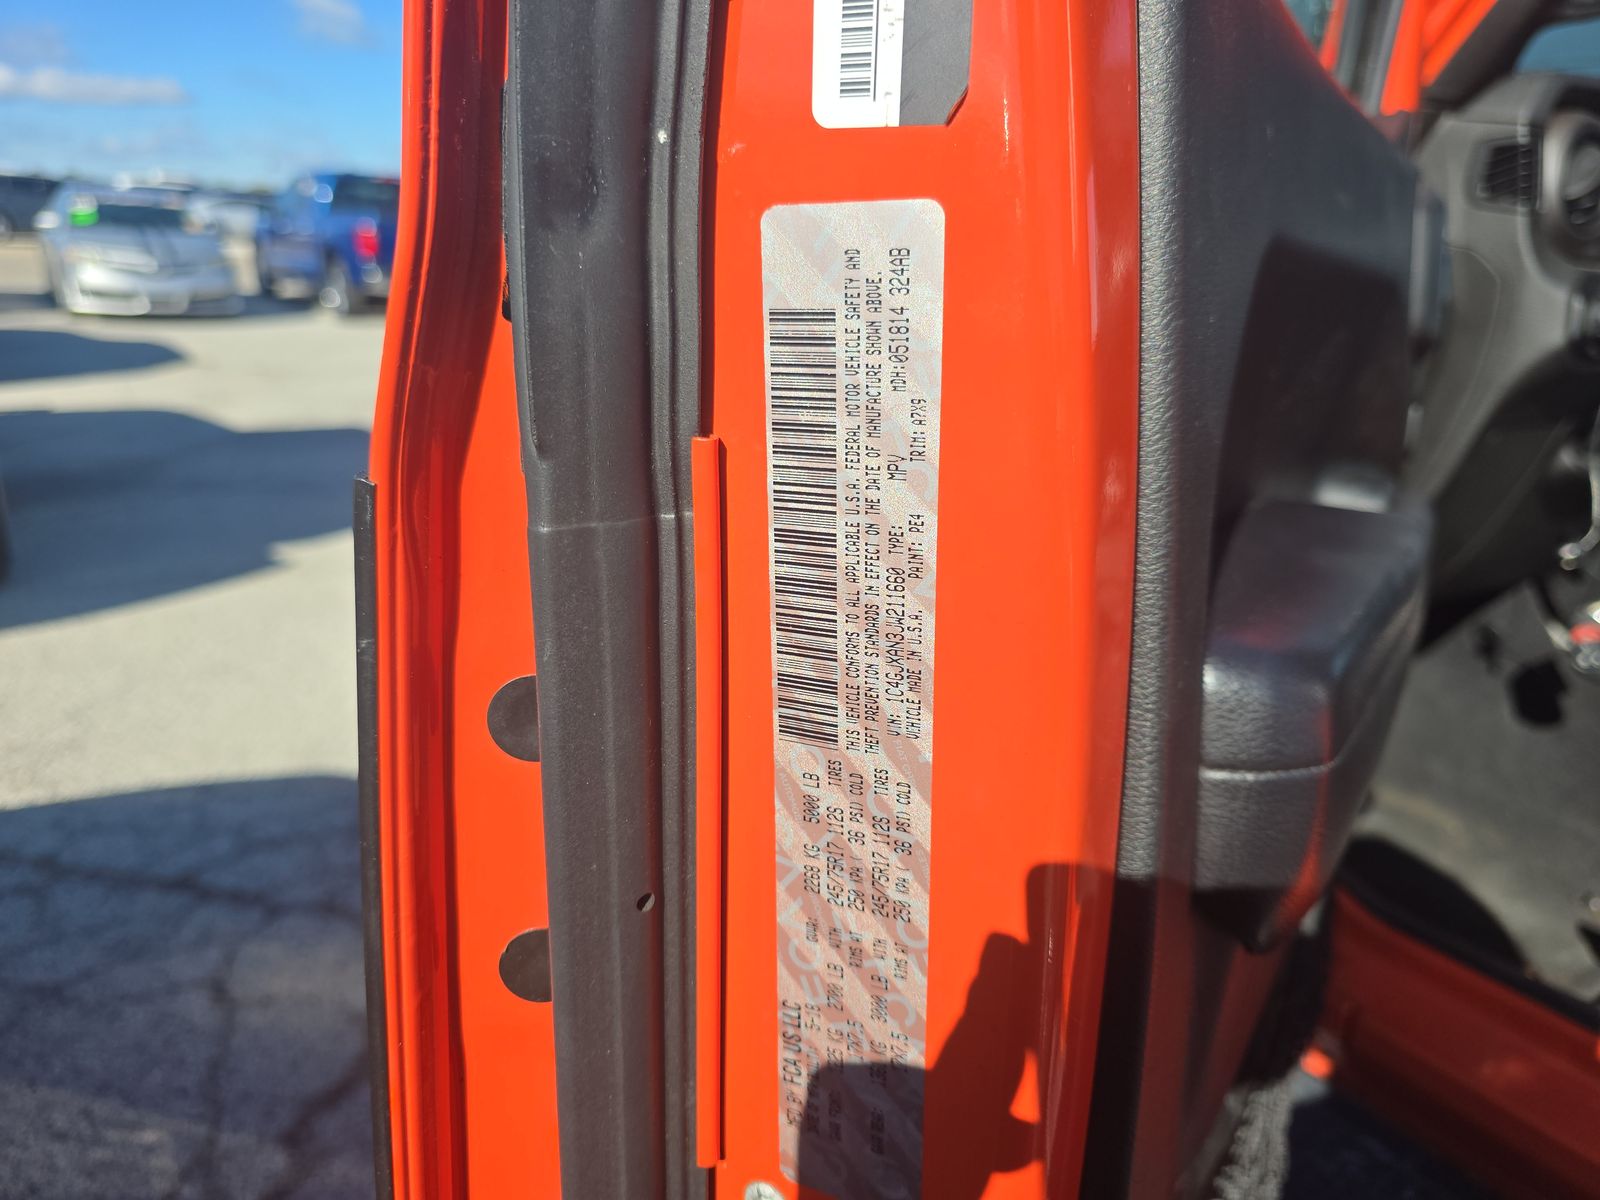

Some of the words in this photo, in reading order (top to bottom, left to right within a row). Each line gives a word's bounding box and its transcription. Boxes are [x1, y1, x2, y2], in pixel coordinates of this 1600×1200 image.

[845, 249, 860, 269] AND
[889, 248, 910, 296] 324AB
[845, 278, 860, 320] SAFETY
[866, 271, 882, 313] ABOVE.
[866, 321, 882, 355] SHOWN
[889, 306, 909, 392] MDH:051814
[845, 328, 860, 376] VEHICLE
[845, 384, 860, 417] MOTOR
[866, 364, 882, 438] MANUFACTURE
[845, 424, 860, 470] FEDERAL
[866, 445, 880, 458] OF
[910, 432, 926, 462] TRIM:
[866, 466, 880, 490] DATE
[887, 454, 907, 481] MPV
[845, 478, 860, 515] U.S.A.
[865, 498, 880, 515] THE
[865, 524, 880, 535] ON
[909, 514, 924, 533] PE4
[845, 522, 860, 583] APPLICABLE
[888, 526, 904, 554] TYPE:
[865, 542, 880, 579] EFFECT
[908, 542, 923, 579] PAINT:
[846, 590, 860, 607] ALL
[865, 586, 880, 596] IN
[846, 614, 860, 624] TO
[864, 604, 879, 658] STANDARDS
[908, 610, 922, 644] U.S.A.
[886, 568, 905, 703] 1C4GJXAN3JW211660
[846, 632, 860, 678] CONFORMS
[907, 651, 922, 661] IN
[864, 664, 879, 722] PREVENTION
[907, 668, 922, 693] MADE
[846, 684, 860, 724] VEHICLE
[887, 714, 902, 736] VIN:
[906, 700, 921, 739] VEHICLE
[846, 730, 860, 751] THIS
[864, 727, 879, 754] THEFT
[803, 773, 820, 788] LB
[829, 760, 842, 786] TIRES
[850, 772, 864, 796] COLD
[874, 768, 888, 796] TIRES
[896, 782, 911, 805] COLD
[804, 795, 820, 824] 5000
[827, 806, 844, 836] 112S
[850, 802, 864, 824] PSI)
[896, 811, 910, 834] PSI)
[848, 829, 864, 846] 36
[872, 816, 890, 846] 112S
[804, 843, 820, 859] KG
[894, 840, 912, 856] 36
[804, 866, 820, 894] 2268
[827, 842, 844, 906] 245/75R17
[850, 866, 863, 884] KPA
[872, 853, 889, 918] 245/75R17
[896, 877, 910, 894] KPA
[849, 890, 864, 912] 250
[894, 900, 911, 923] 250
[828, 963, 843, 979] LB
[871, 974, 888, 990] LB
[828, 984, 843, 1011] 2700
[871, 994, 887, 1023] 3000
[782, 1000, 800, 1028] LLC
[783, 1032, 800, 1052] US
[828, 1028, 843, 1043] KG
[870, 1040, 886, 1056] KG
[783, 1058, 801, 1085] FCA
